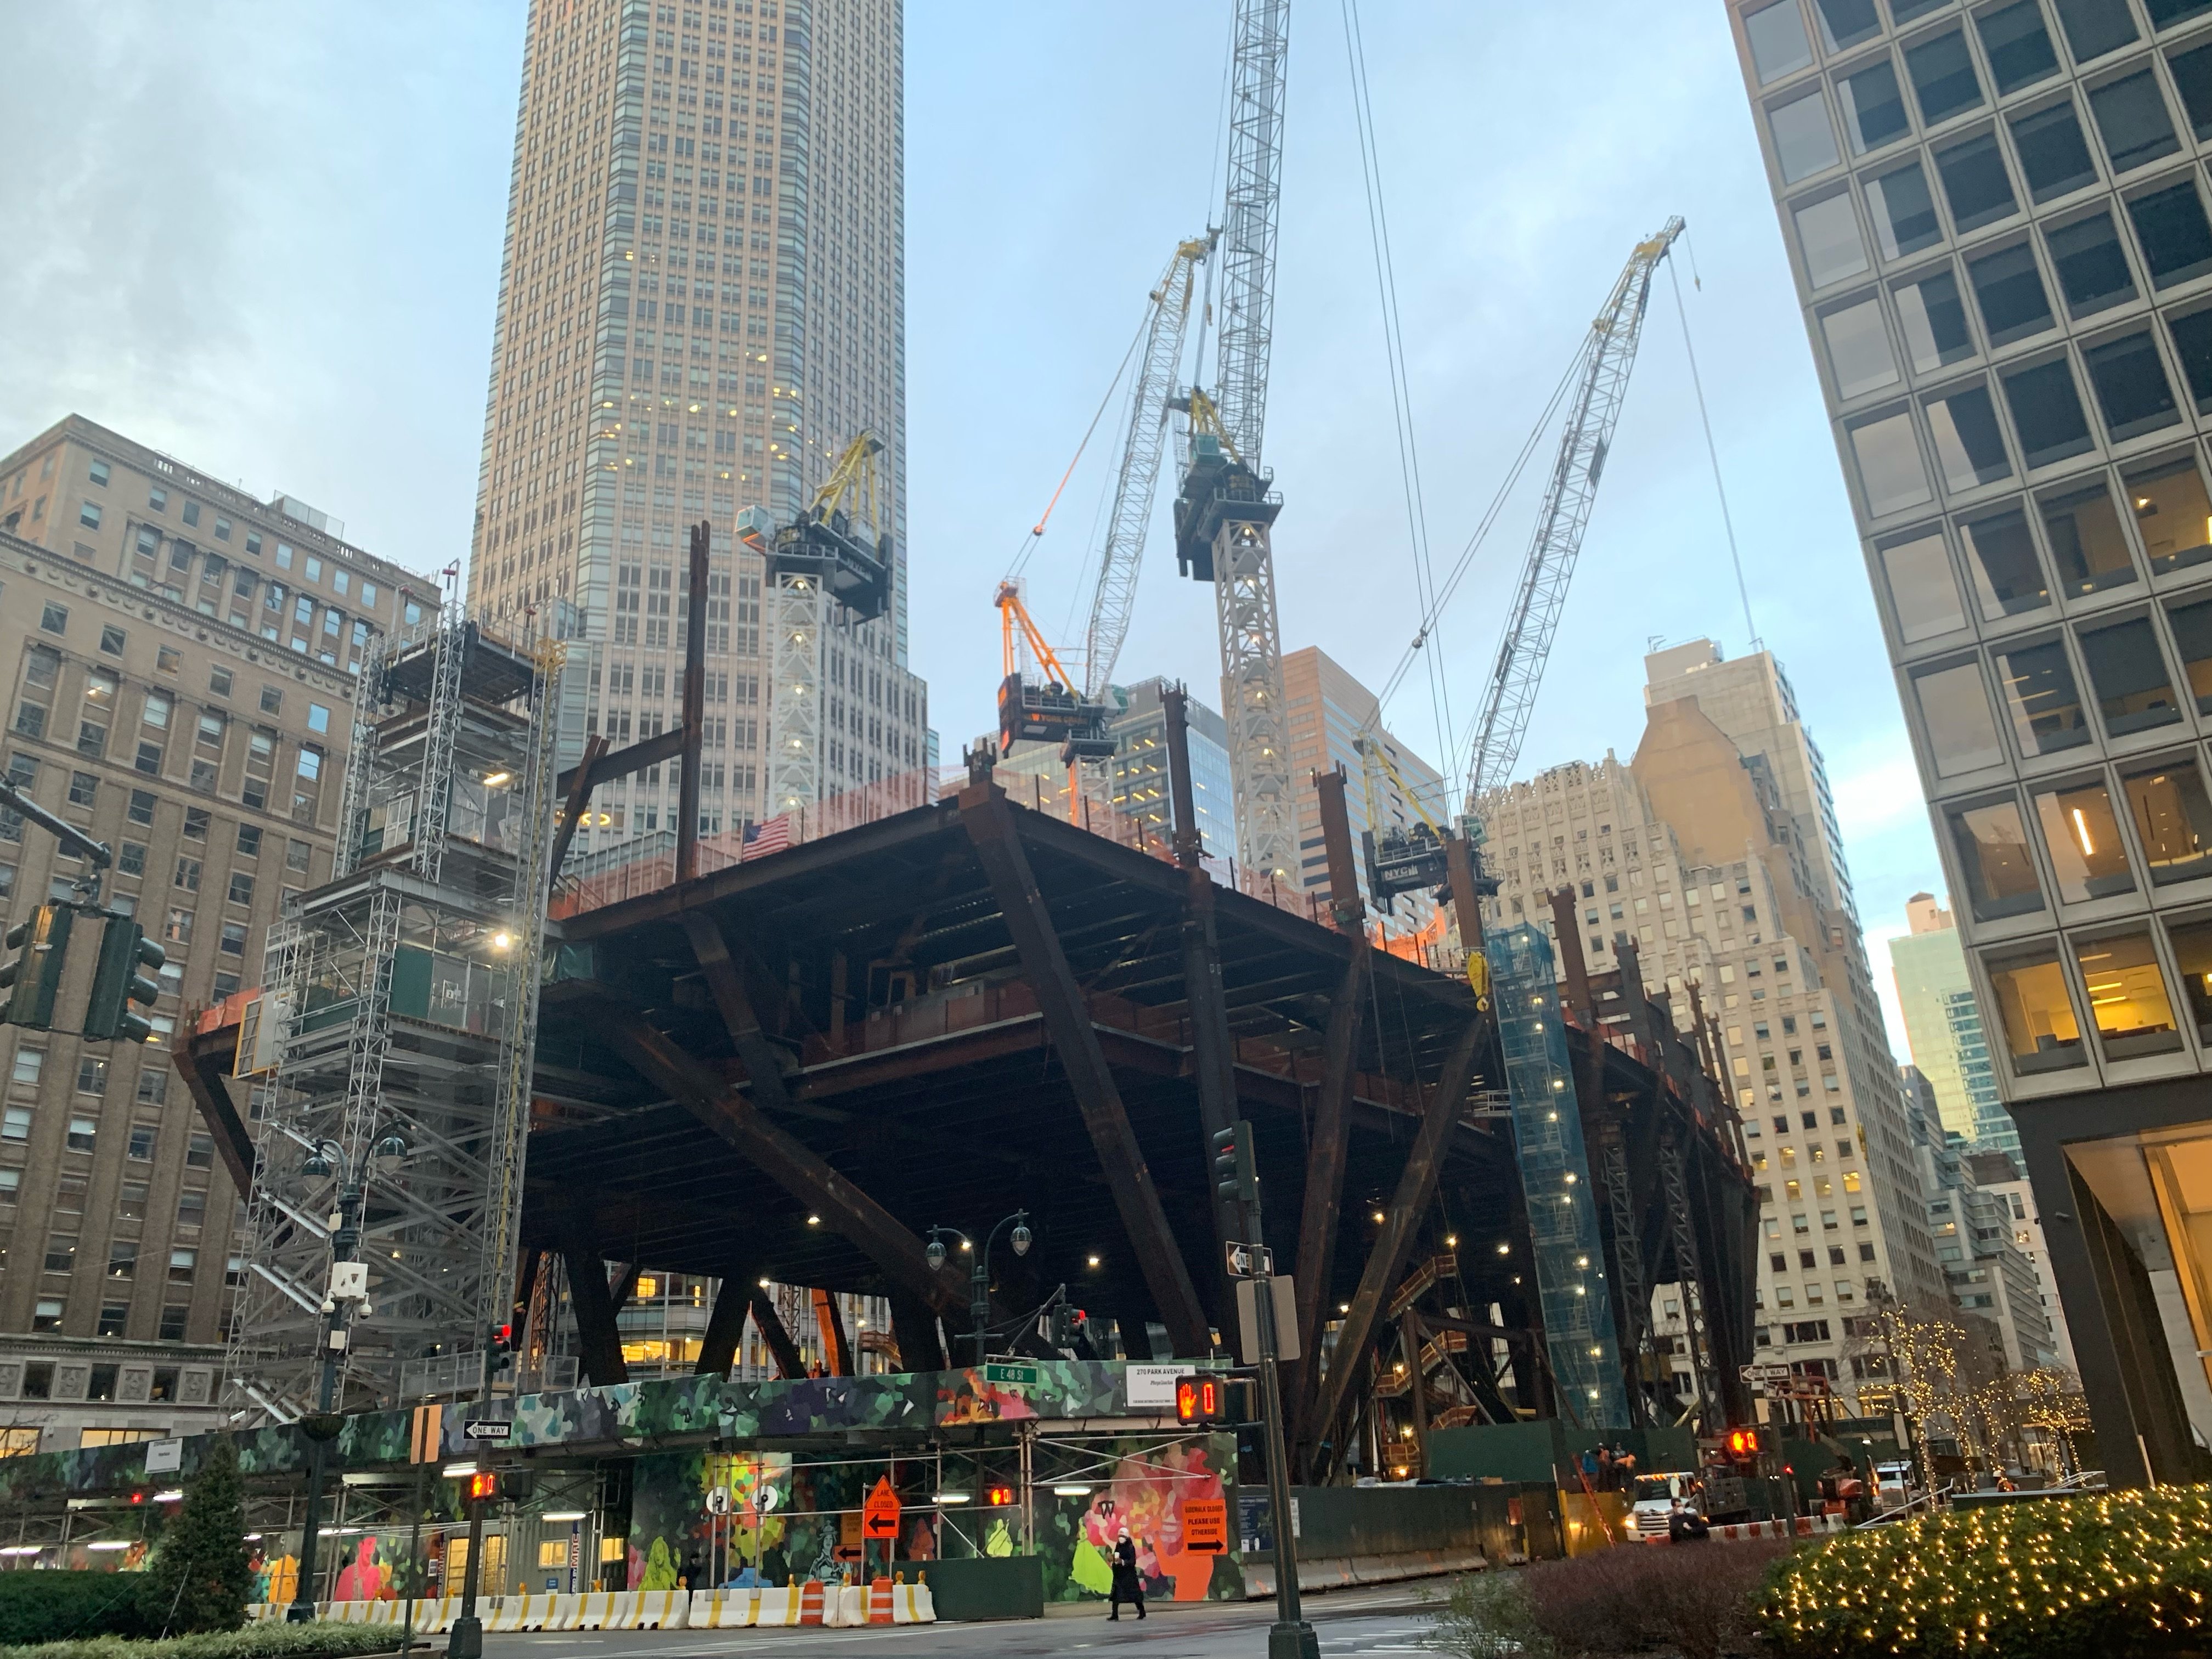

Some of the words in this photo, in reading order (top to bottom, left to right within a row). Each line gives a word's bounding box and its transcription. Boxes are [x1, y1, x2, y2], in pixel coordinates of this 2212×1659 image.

[1384, 866, 1408, 879] NYC
[1236, 1254, 1249, 1267] ONE
[1000, 1368, 1005, 1379] E
[1006, 1369, 1015, 1380] 48
[1017, 1369, 1024, 1380] St
[571, 1533, 580, 1568] MAC
